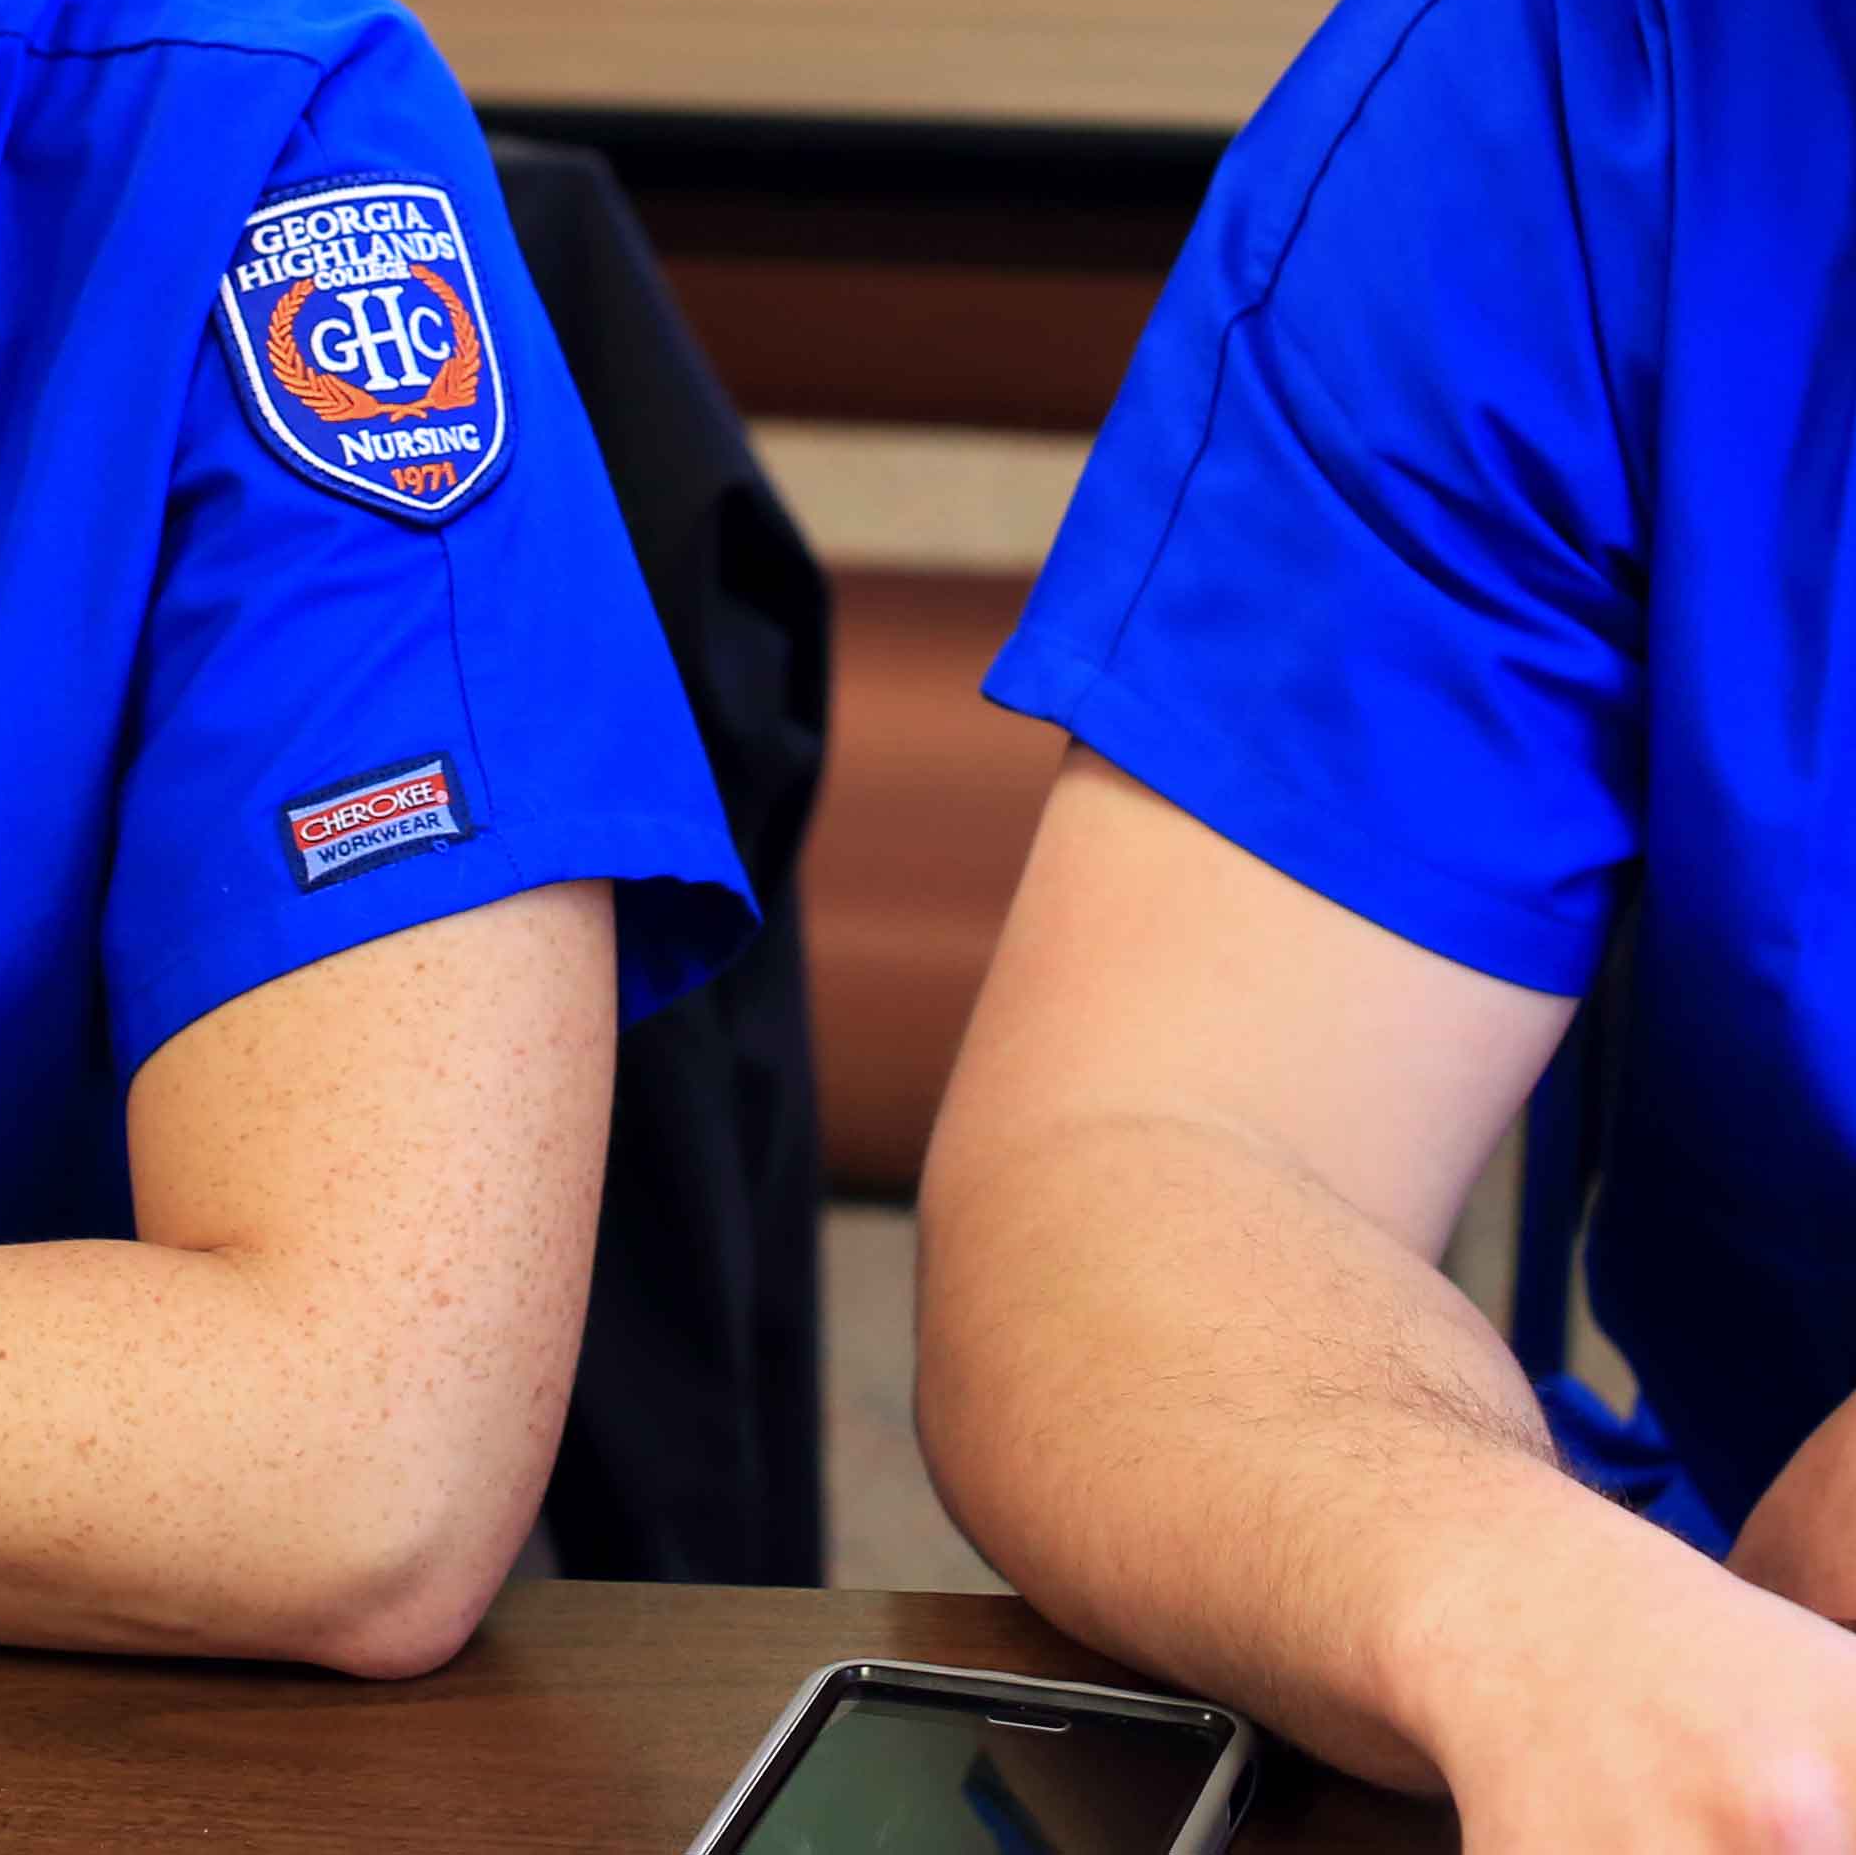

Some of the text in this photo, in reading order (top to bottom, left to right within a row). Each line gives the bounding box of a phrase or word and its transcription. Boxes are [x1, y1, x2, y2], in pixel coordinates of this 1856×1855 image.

[251, 201, 433, 255] GEORGIA
[236, 232, 456, 293] HIGHLANDS
[314, 261, 412, 291] COLLEGE
[309, 285, 451, 392] GHC
[337, 424, 480, 466] NURSING
[391, 461, 457, 496] 1971
[300, 781, 435, 841] CHEROKEE
[317, 812, 442, 864] WORKWEAR
